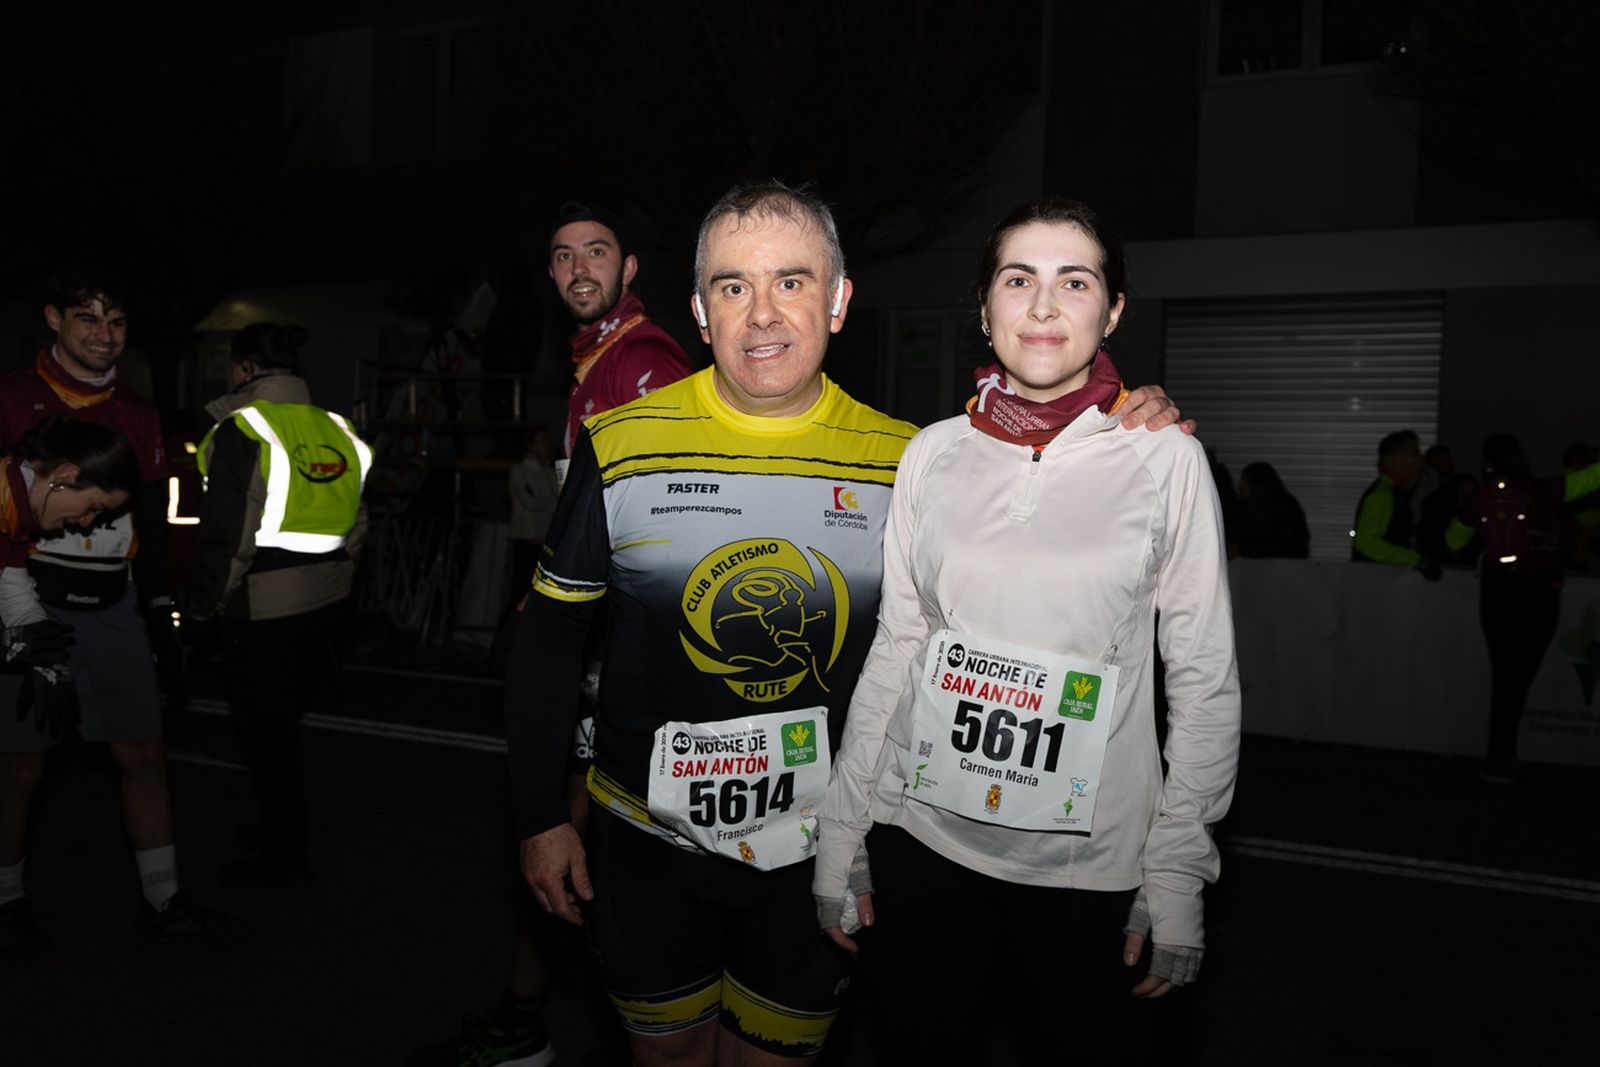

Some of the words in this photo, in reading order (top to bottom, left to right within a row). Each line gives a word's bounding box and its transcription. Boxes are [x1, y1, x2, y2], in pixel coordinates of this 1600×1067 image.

[991, 414, 1004, 427] SAN
[992, 406, 1013, 427] NOCHE
[1012, 422, 1022, 434] DE
[995, 399, 1037, 431] INTERNACION
[667, 483, 720, 494] FASTER
[650, 504, 743, 516] #teamperezcampos
[824, 509, 868, 522] Diputación
[824, 518, 837, 527] de
[838, 518, 869, 531] Córdoba
[686, 578, 712, 613] CLUB
[710, 542, 779, 580] ATLETISMO
[949, 648, 964, 664] 43
[968, 649, 989, 659] CARRERA
[989, 653, 1009, 664] URBANA
[964, 656, 1023, 684] NOCHE
[1022, 672, 1048, 689] DE
[743, 680, 788, 698] RUTE
[941, 672, 977, 697] SAN
[977, 681, 1044, 712] ANTÓN
[673, 736, 690, 749] 43
[694, 737, 744, 755] NOCHE
[748, 734, 767, 752] DE
[951, 700, 1066, 773] 5611
[672, 758, 708, 777] SAN
[710, 753, 769, 775] ANTÓN
[960, 757, 1002, 779] Carmen
[1005, 769, 1039, 787] María
[689, 771, 795, 828] 5614
[717, 823, 764, 841] Francisco
